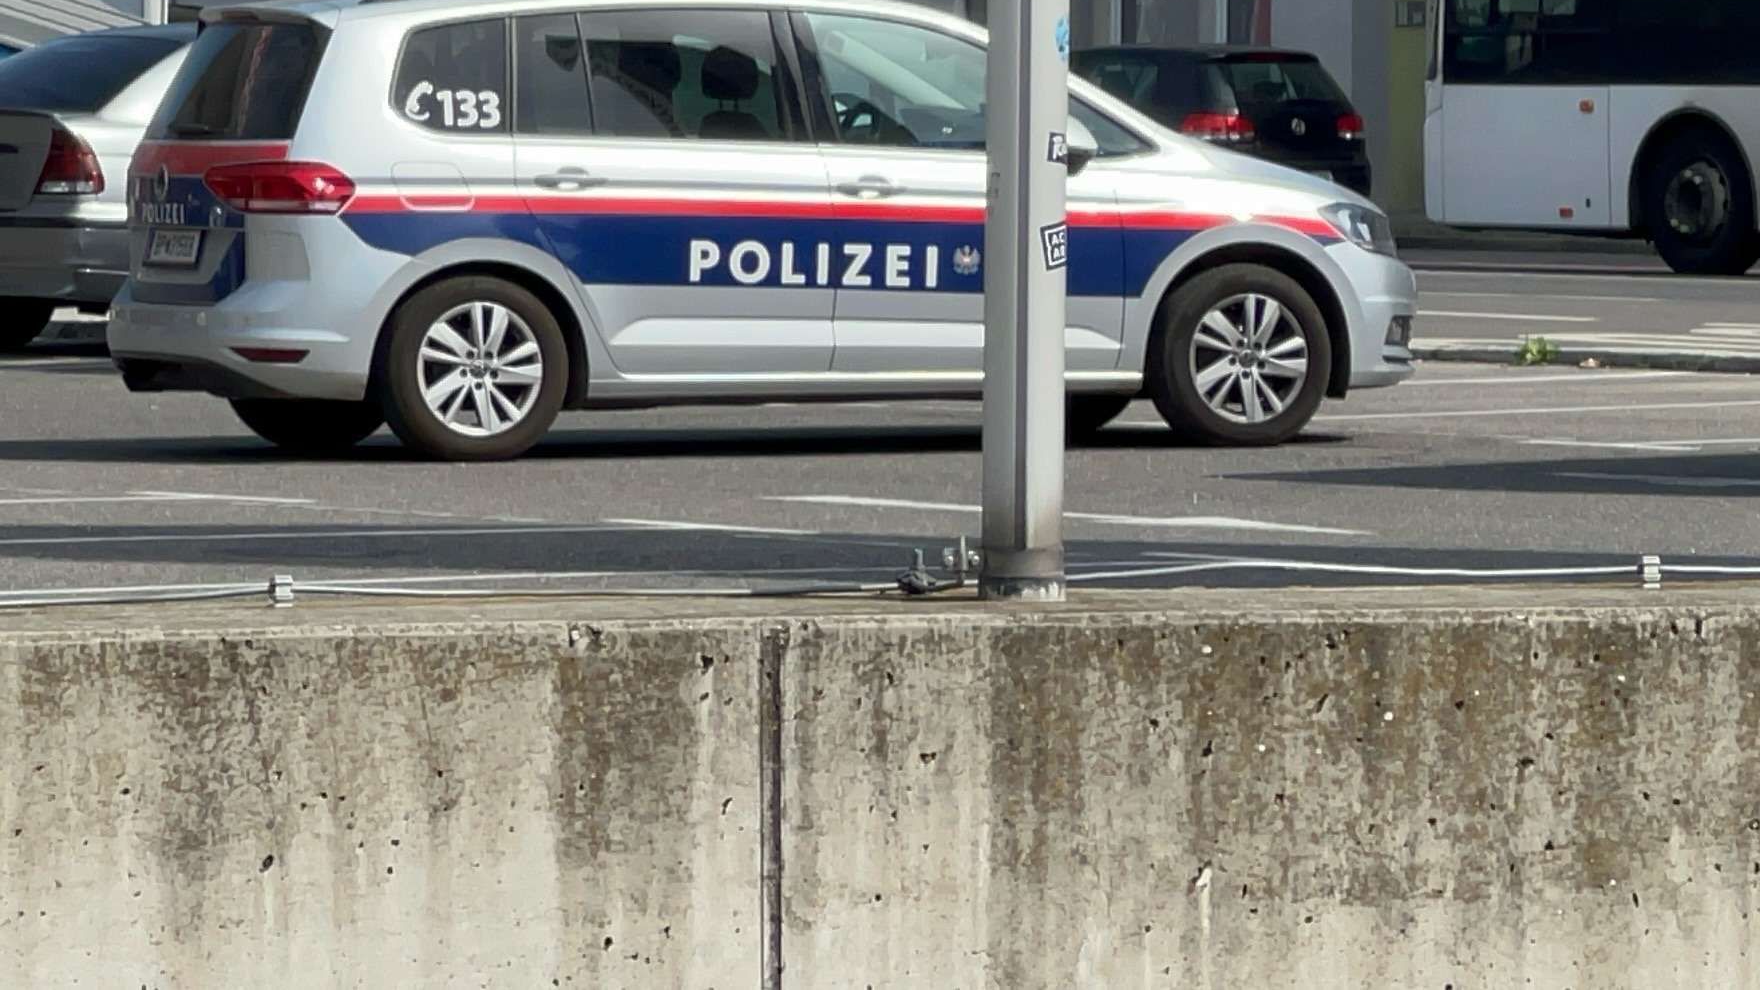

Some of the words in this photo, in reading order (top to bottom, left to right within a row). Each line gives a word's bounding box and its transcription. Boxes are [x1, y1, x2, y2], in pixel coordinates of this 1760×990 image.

[436, 89, 501, 128] 133
[142, 203, 184, 225] POLIZEI
[689, 240, 938, 288] POLIZEI
